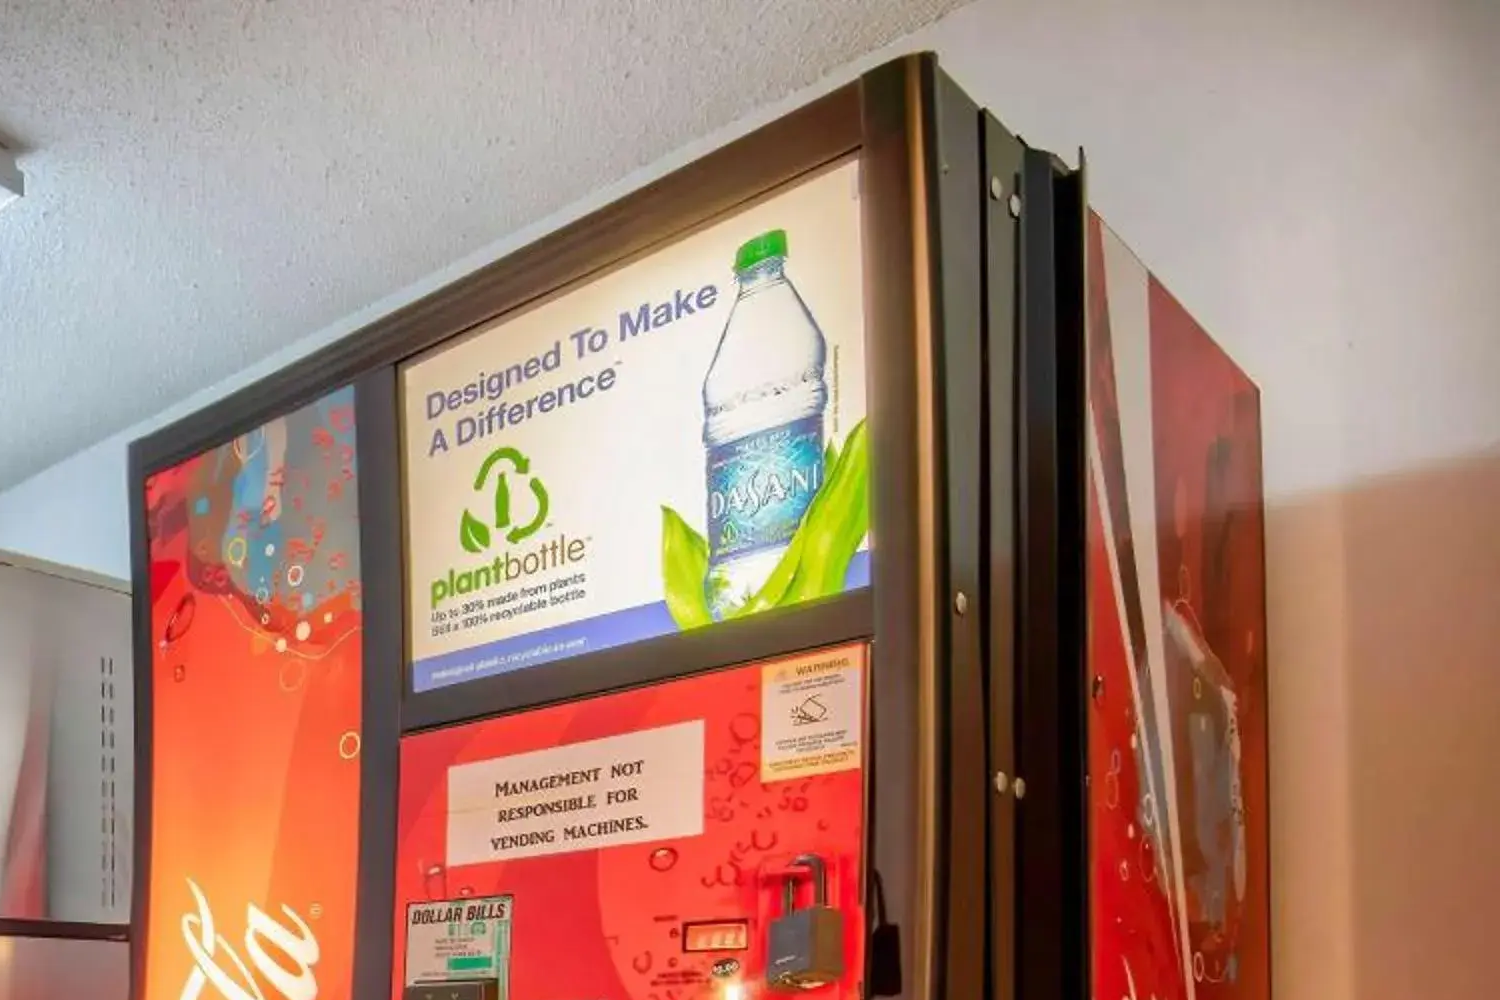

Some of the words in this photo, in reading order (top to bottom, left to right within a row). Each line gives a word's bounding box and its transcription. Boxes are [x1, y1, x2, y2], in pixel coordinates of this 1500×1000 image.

[426, 341, 561, 420] Designed
[570, 327, 608, 360] To
[619, 284, 718, 342] Make
[429, 428, 449, 457] A
[711, 463, 818, 520] DASANI
[431, 534, 586, 610] plantbottle
[495, 767, 602, 798] MANAGEMENT
[611, 760, 644, 778] NOT
[498, 795, 597, 823] RESPONSIBLE
[607, 787, 639, 805] FOR
[491, 830, 555, 851] VENDING
[563, 816, 649, 841] MACHINES.
[412, 906, 463, 926] DOLLAR
[466, 903, 506, 922] BILLS
